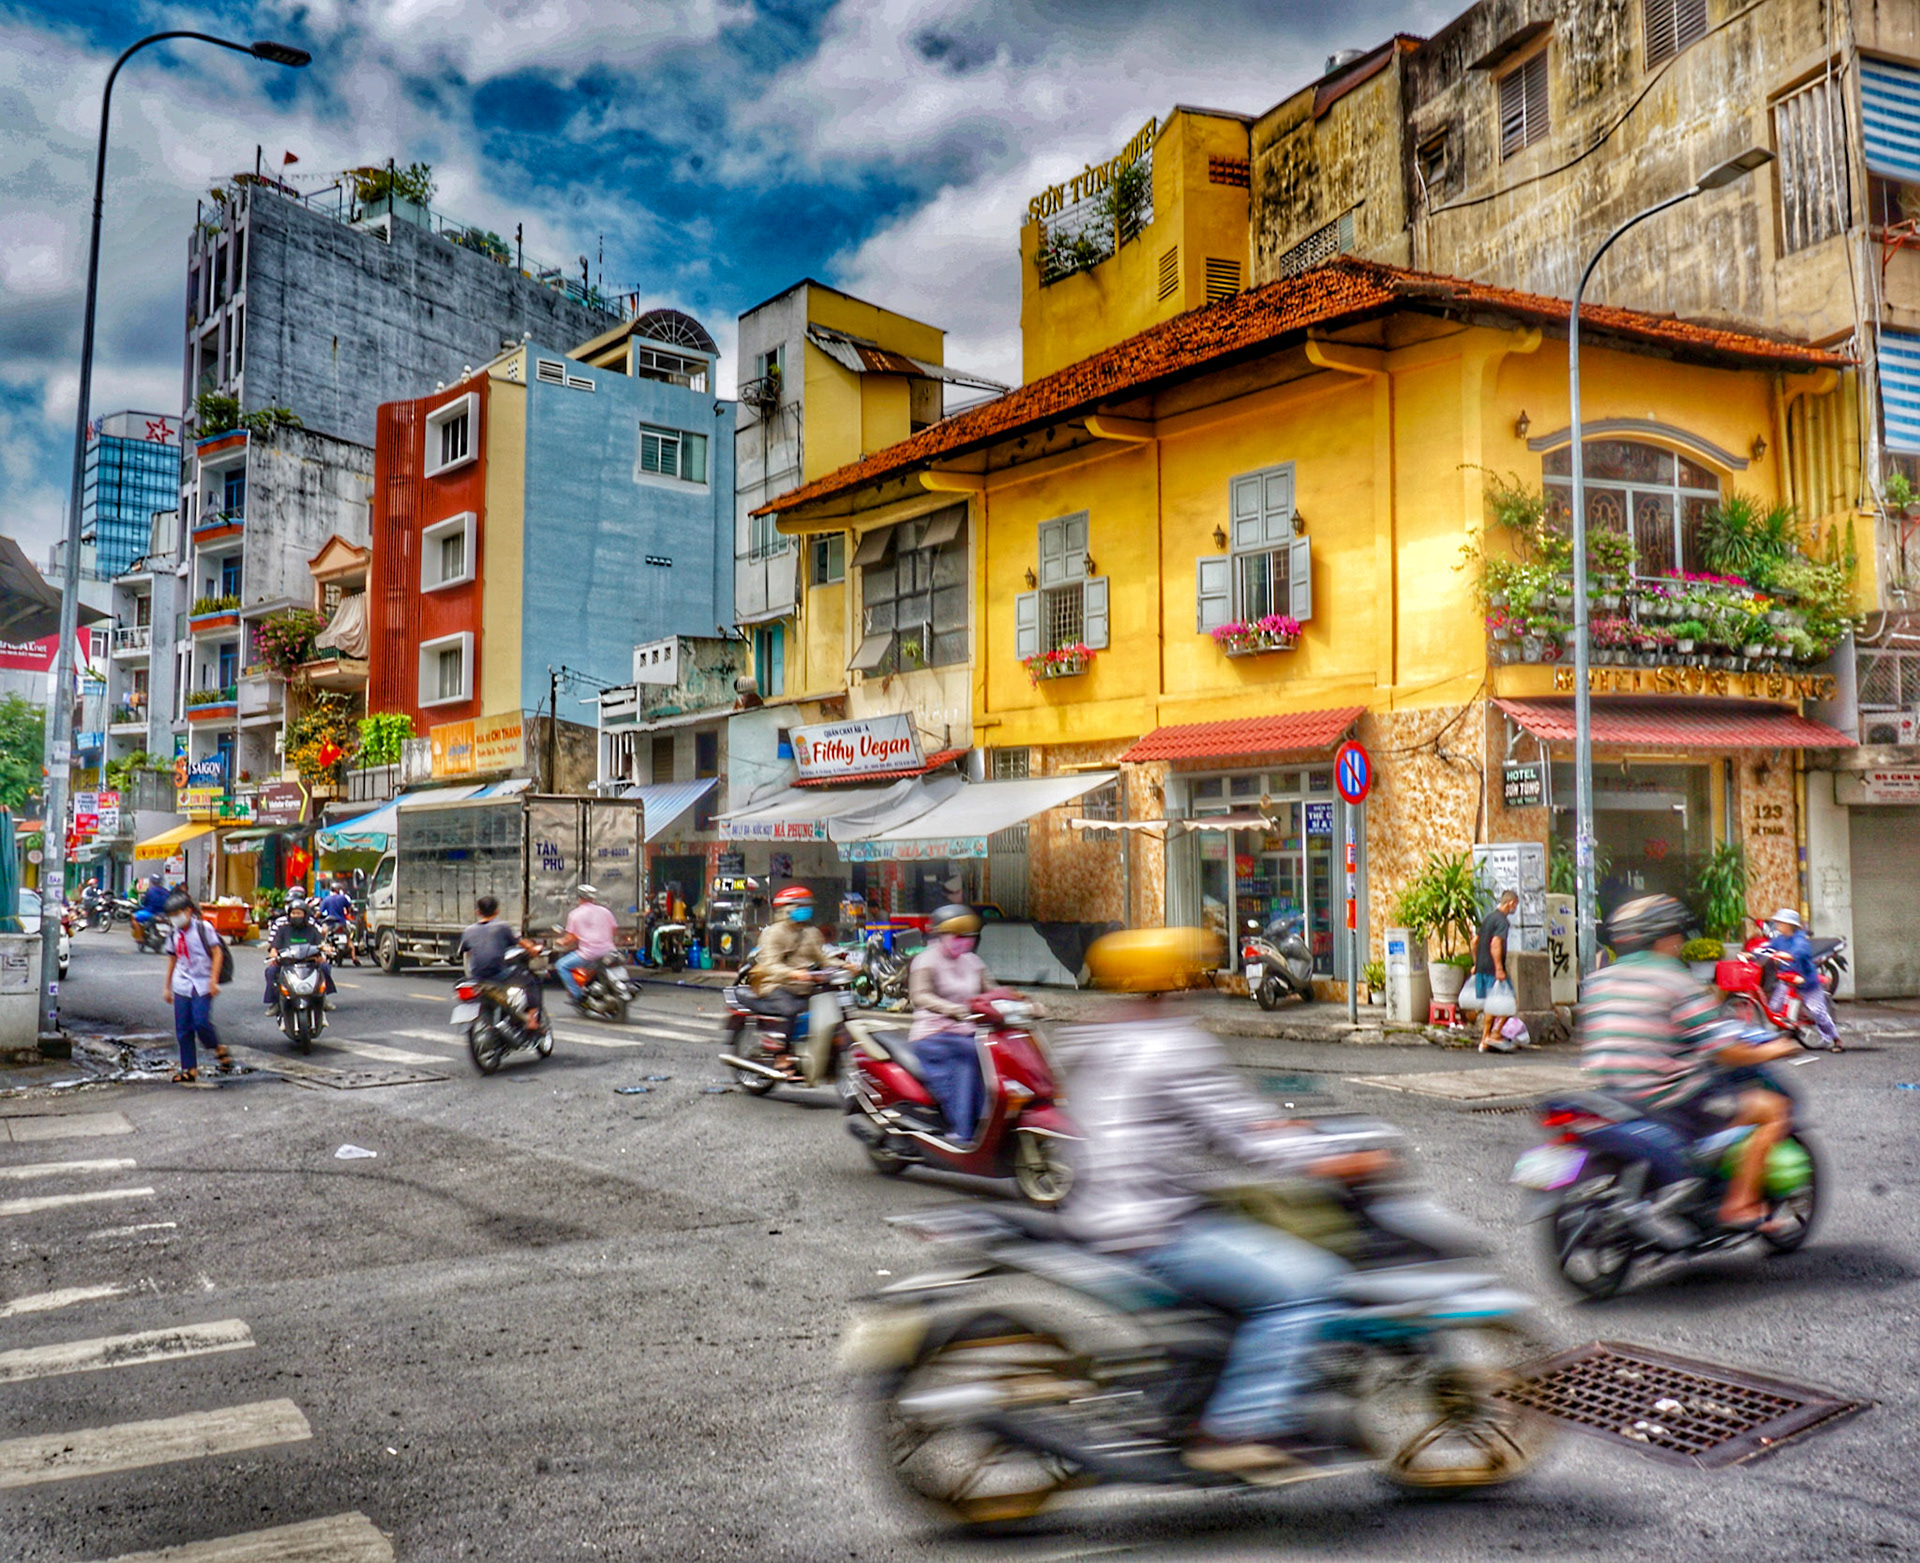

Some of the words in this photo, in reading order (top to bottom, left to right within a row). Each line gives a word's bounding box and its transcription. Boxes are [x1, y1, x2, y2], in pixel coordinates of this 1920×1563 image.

[1028, 184, 1065, 223] SƠN
[1069, 155, 1124, 204] TÙNG
[1121, 116, 1157, 169] HOTEL
[813, 738, 854, 766] Filthy
[861, 734, 910, 762] Vegan
[192, 762, 220, 774] SAIGON
[1506, 768, 1537, 781] HOTEL
[1505, 781, 1519, 797] SƠN
[1753, 804, 1783, 819] 123
[787, 822, 813, 839] PHỤNG
[536, 840, 557, 856] TÂN
[543, 855, 564, 871] PHÚ
